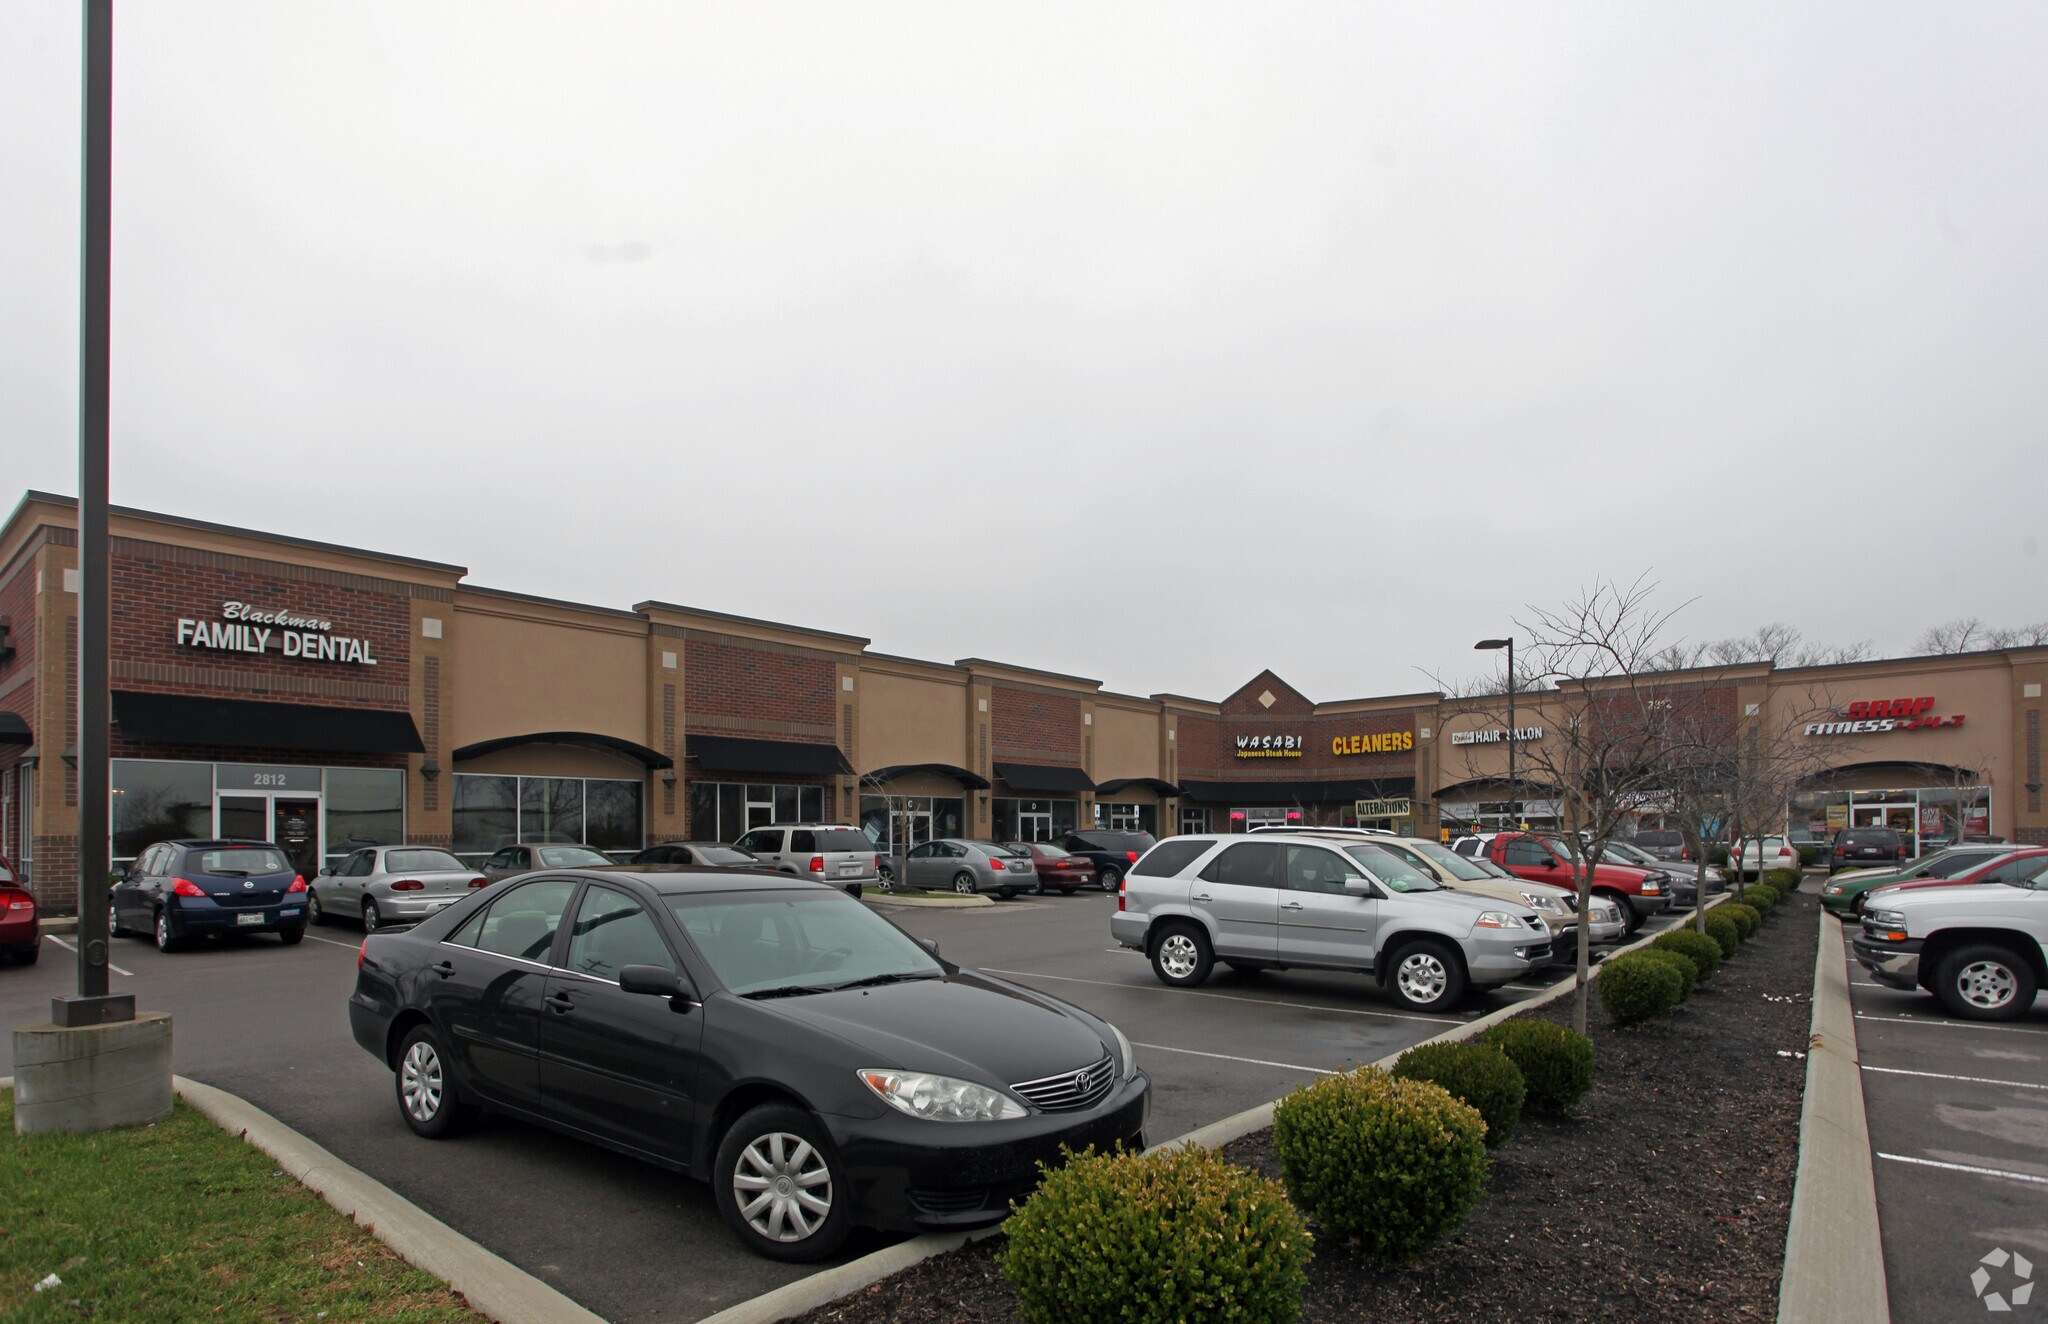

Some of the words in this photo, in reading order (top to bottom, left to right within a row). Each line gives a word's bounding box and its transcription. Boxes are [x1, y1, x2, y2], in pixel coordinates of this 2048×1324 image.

[223, 601, 332, 631] Blackman
[177, 618, 271, 653] FAMILY
[283, 630, 377, 665] DENTAL
[1804, 719, 1895, 736] FITNESS
[1236, 735, 1302, 749] WASABI
[1332, 731, 1413, 755] CLEANERS
[1475, 729, 1500, 743] HAIR
[1237, 749, 1265, 758] Japanese
[1265, 749, 1283, 757] Steak
[1283, 749, 1302, 757] House
[254, 773, 286, 785] 2812
[1357, 800, 1409, 815] ALTERATIONS
